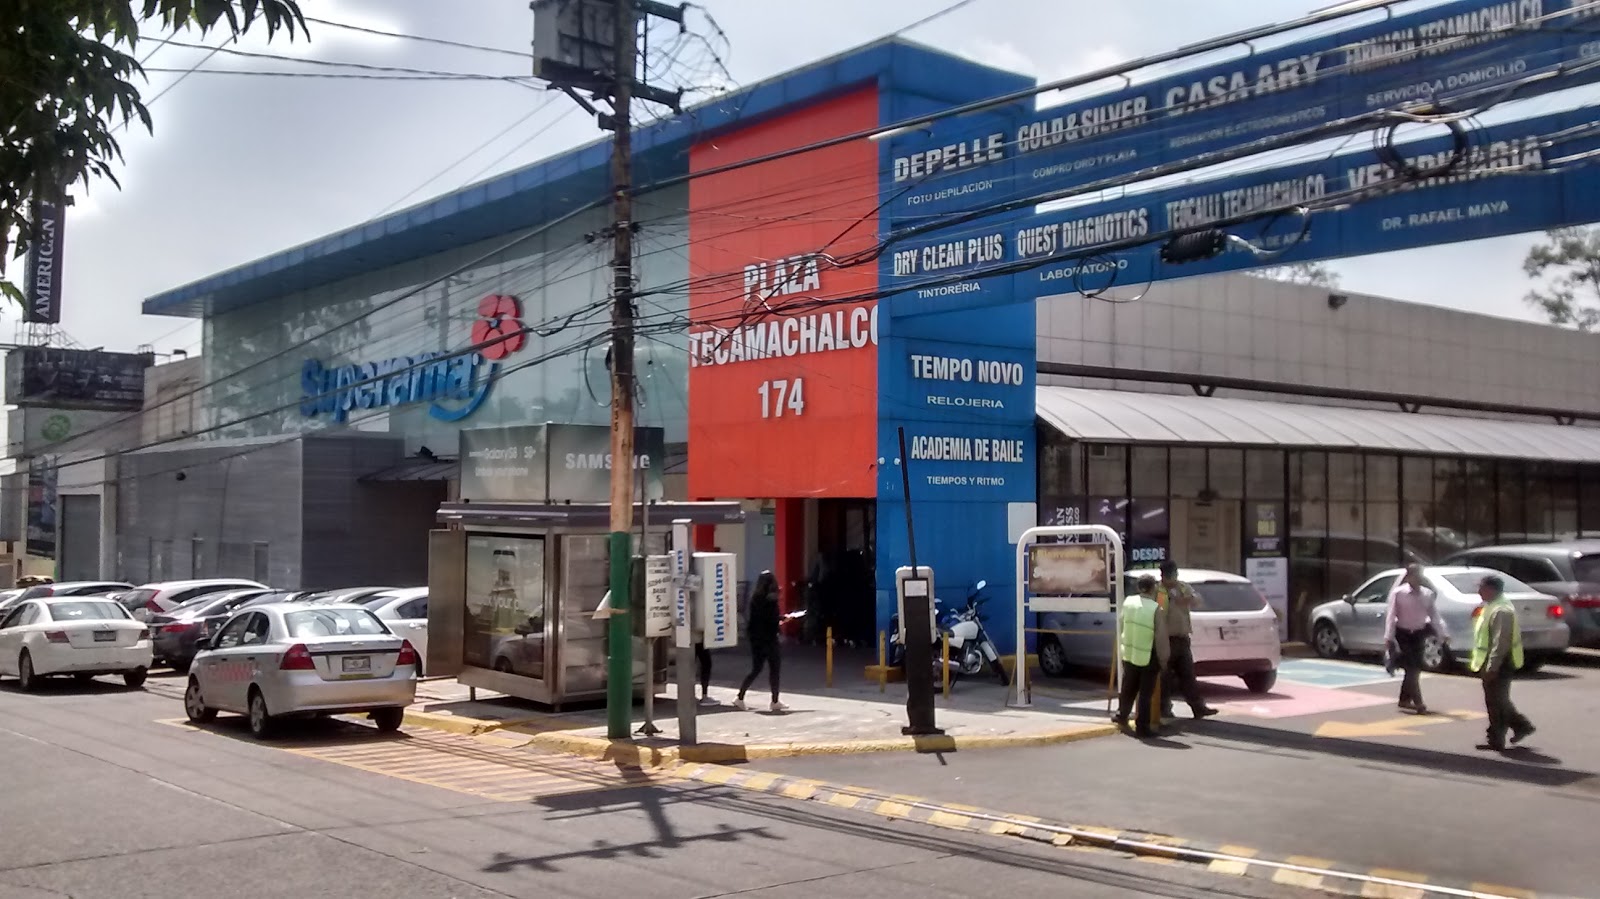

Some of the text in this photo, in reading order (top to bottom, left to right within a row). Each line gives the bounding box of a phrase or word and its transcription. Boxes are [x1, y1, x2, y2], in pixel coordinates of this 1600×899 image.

[1166, 53, 1321, 117] CASA ARY
[1446, 60, 1527, 89] DOMICILIO
[894, 132, 1003, 182] DEPELLE
[1033, 162, 1072, 178] COMPRO
[1073, 158, 1096, 170] ORO
[907, 180, 993, 206] FOTO DEPILACION
[1382, 200, 1509, 231] DR. RAFAEL MAYA
[1018, 208, 1148, 256] QUEST DIAGNOTICS
[894, 233, 1003, 277] DRY CLEAN PLUS
[744, 253, 820, 302] PLAZA
[918, 282, 981, 299] TINTORERIA
[911, 355, 1024, 386] TEMPO NOVO
[758, 378, 804, 418] 174
[927, 396, 1004, 409] RELOJERIA
[565, 453, 650, 470] SAMSG
[911, 436, 1023, 463] ACADEMIA DE BAILE
[927, 476, 1004, 487] TIEMPOS Y RITMO
[1132, 547, 1166, 561] DESDE
[714, 562, 725, 642] infinitum
